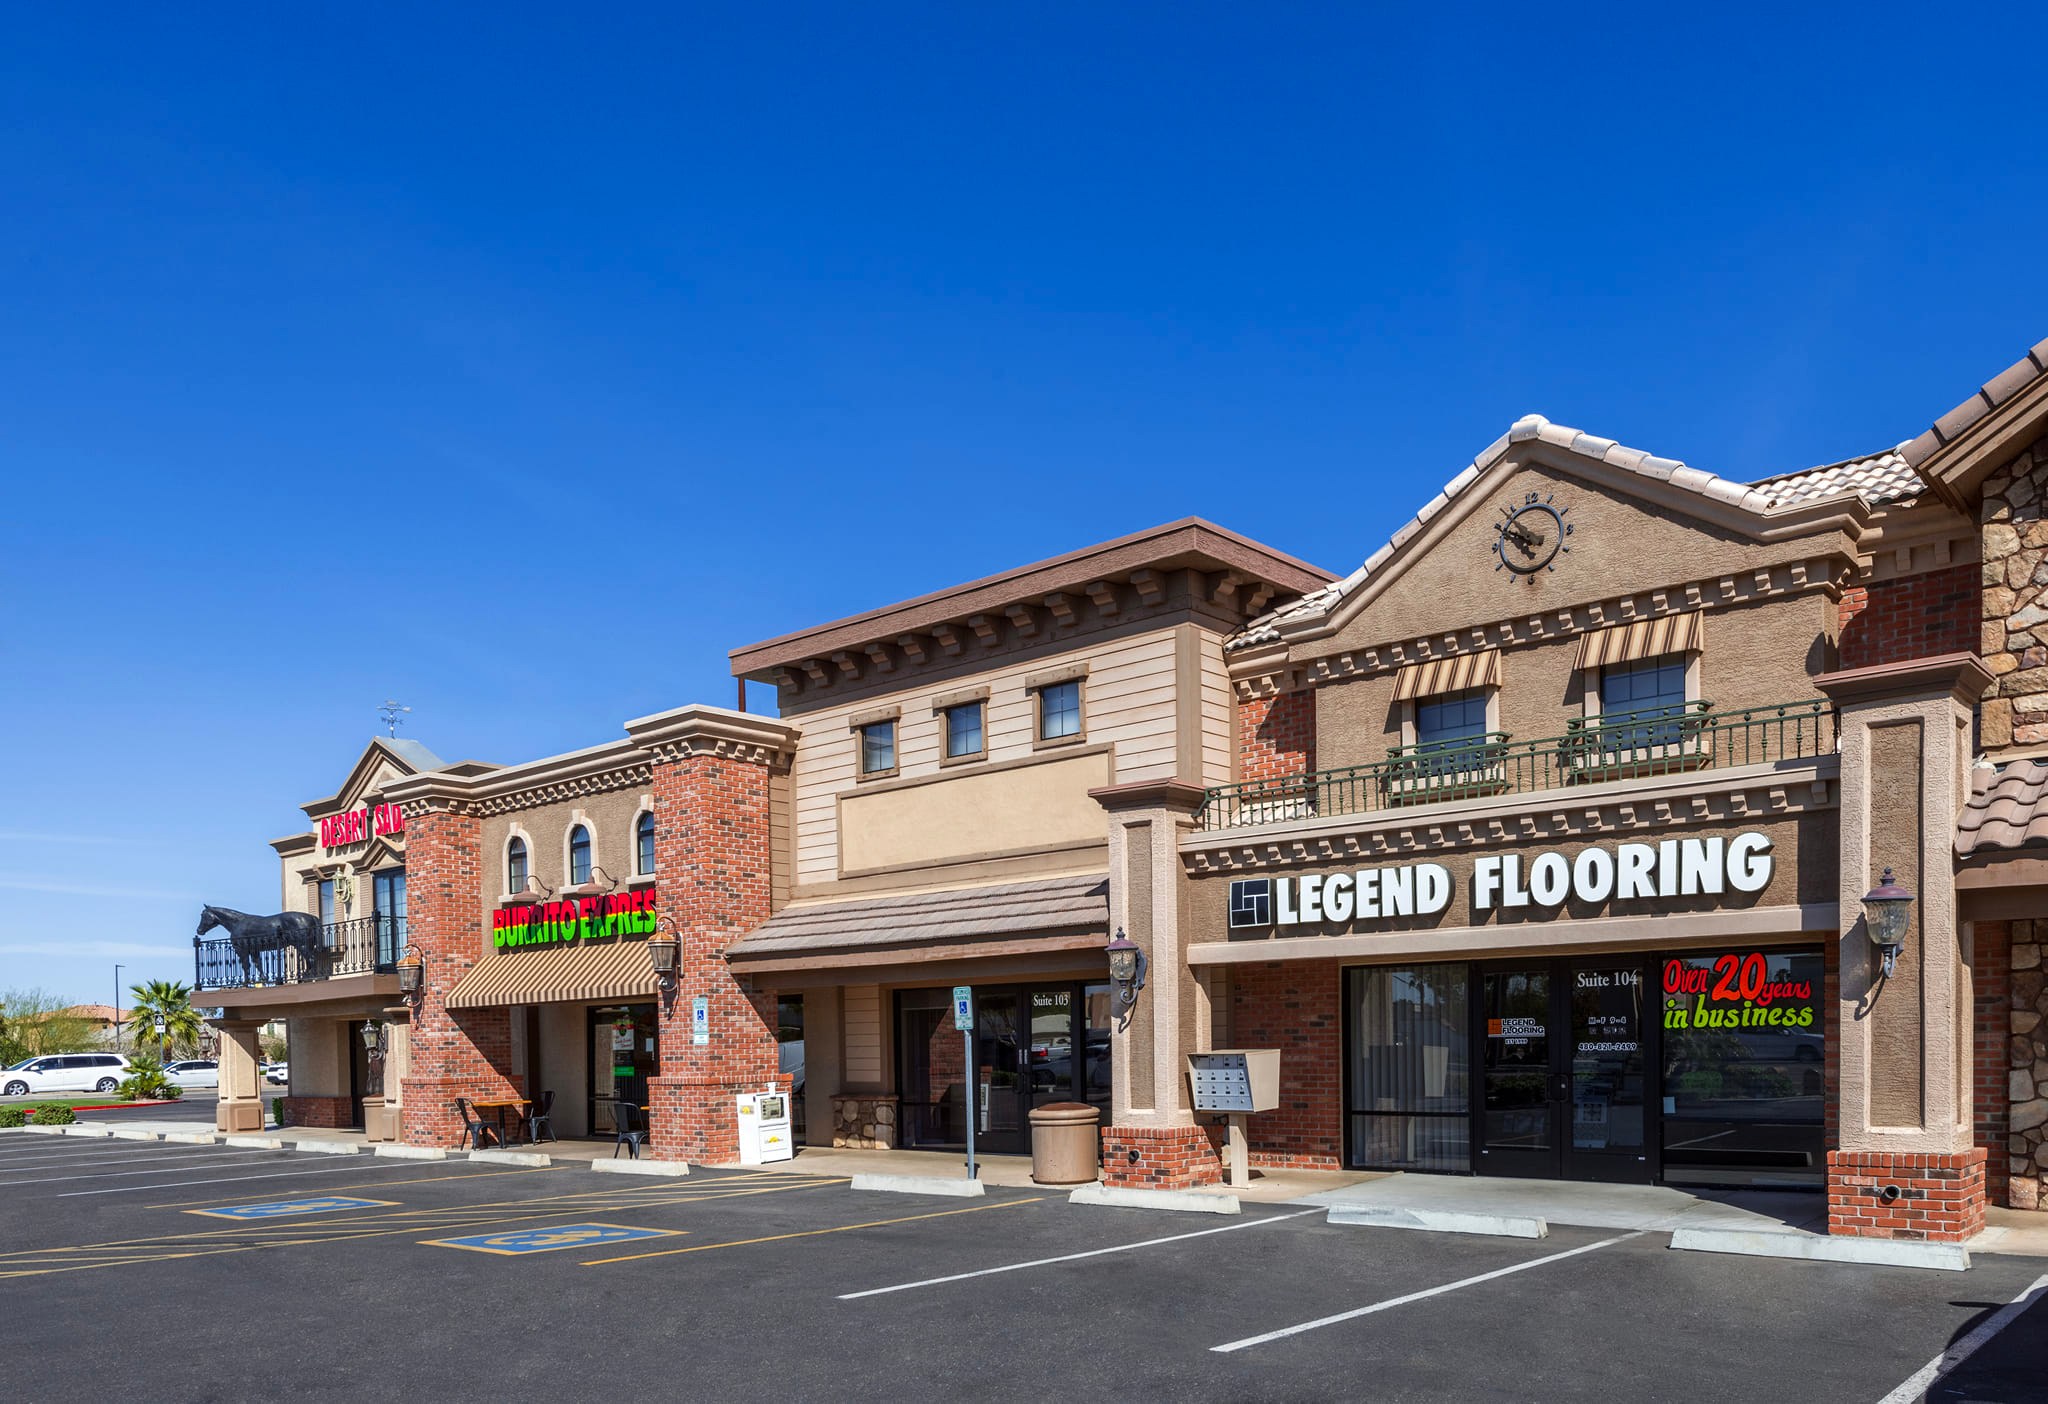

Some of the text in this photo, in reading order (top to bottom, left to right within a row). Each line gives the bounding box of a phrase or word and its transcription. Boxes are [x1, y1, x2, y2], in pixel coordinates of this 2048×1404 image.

[321, 802, 405, 848] DESERT SAD
[1276, 832, 1775, 925] LEGEND FLOORING
[493, 900, 577, 948] BURRITO
[1577, 971, 1638, 988] Suite 104
[1663, 952, 1811, 1006] Over 20 years
[1033, 994, 1069, 1006] Suite 103
[1664, 994, 1813, 1029] in business
[1502, 1018, 1535, 1026] LEGEND
[1502, 1026, 1545, 1034] FLOORING
[1578, 1042, 1637, 1051] 480-821-2499
